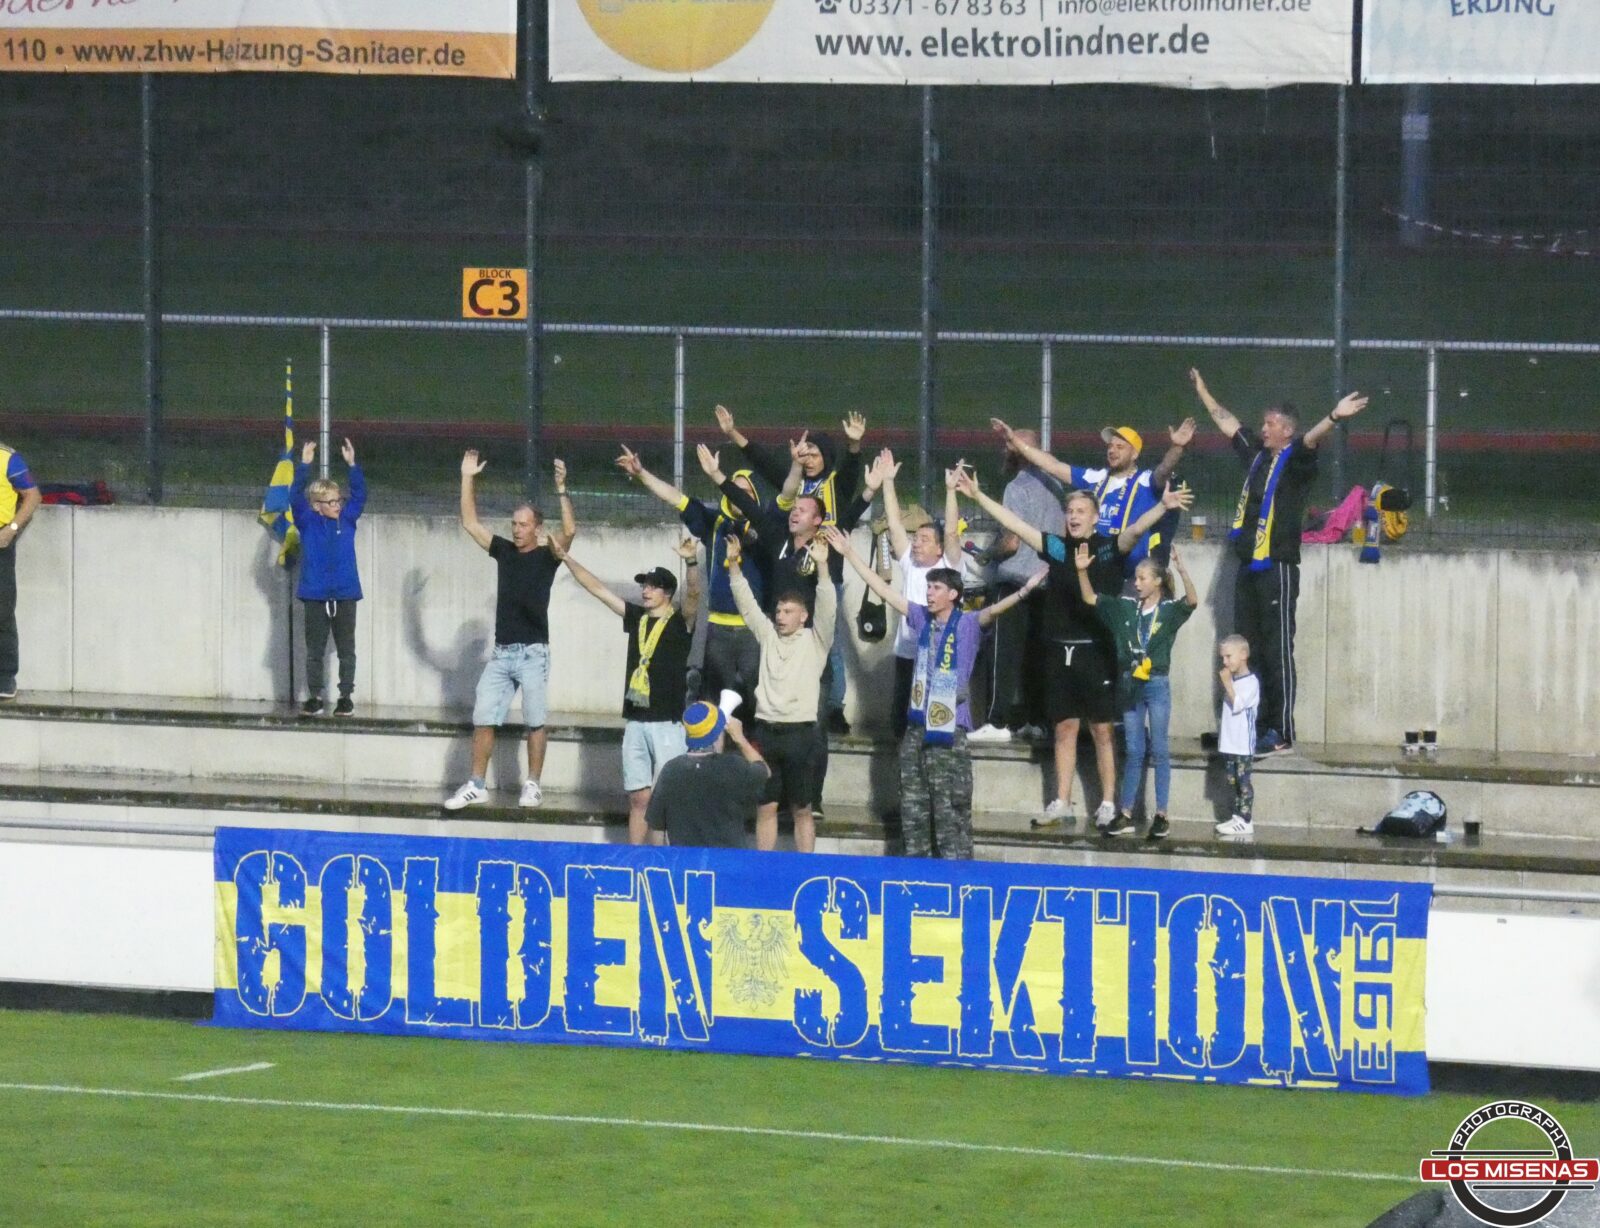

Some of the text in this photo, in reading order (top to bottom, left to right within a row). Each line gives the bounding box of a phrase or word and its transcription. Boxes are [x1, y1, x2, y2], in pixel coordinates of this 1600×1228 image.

[4, 37, 466, 67] 110 www.zhw-Heizung-Sanitaer.de
[479, 269, 512, 279] BLOCK
[468, 278, 521, 317] C3
[234, 850, 1344, 1086] GOLDEN SEKTION
[1350, 892, 1399, 1084] 1963
